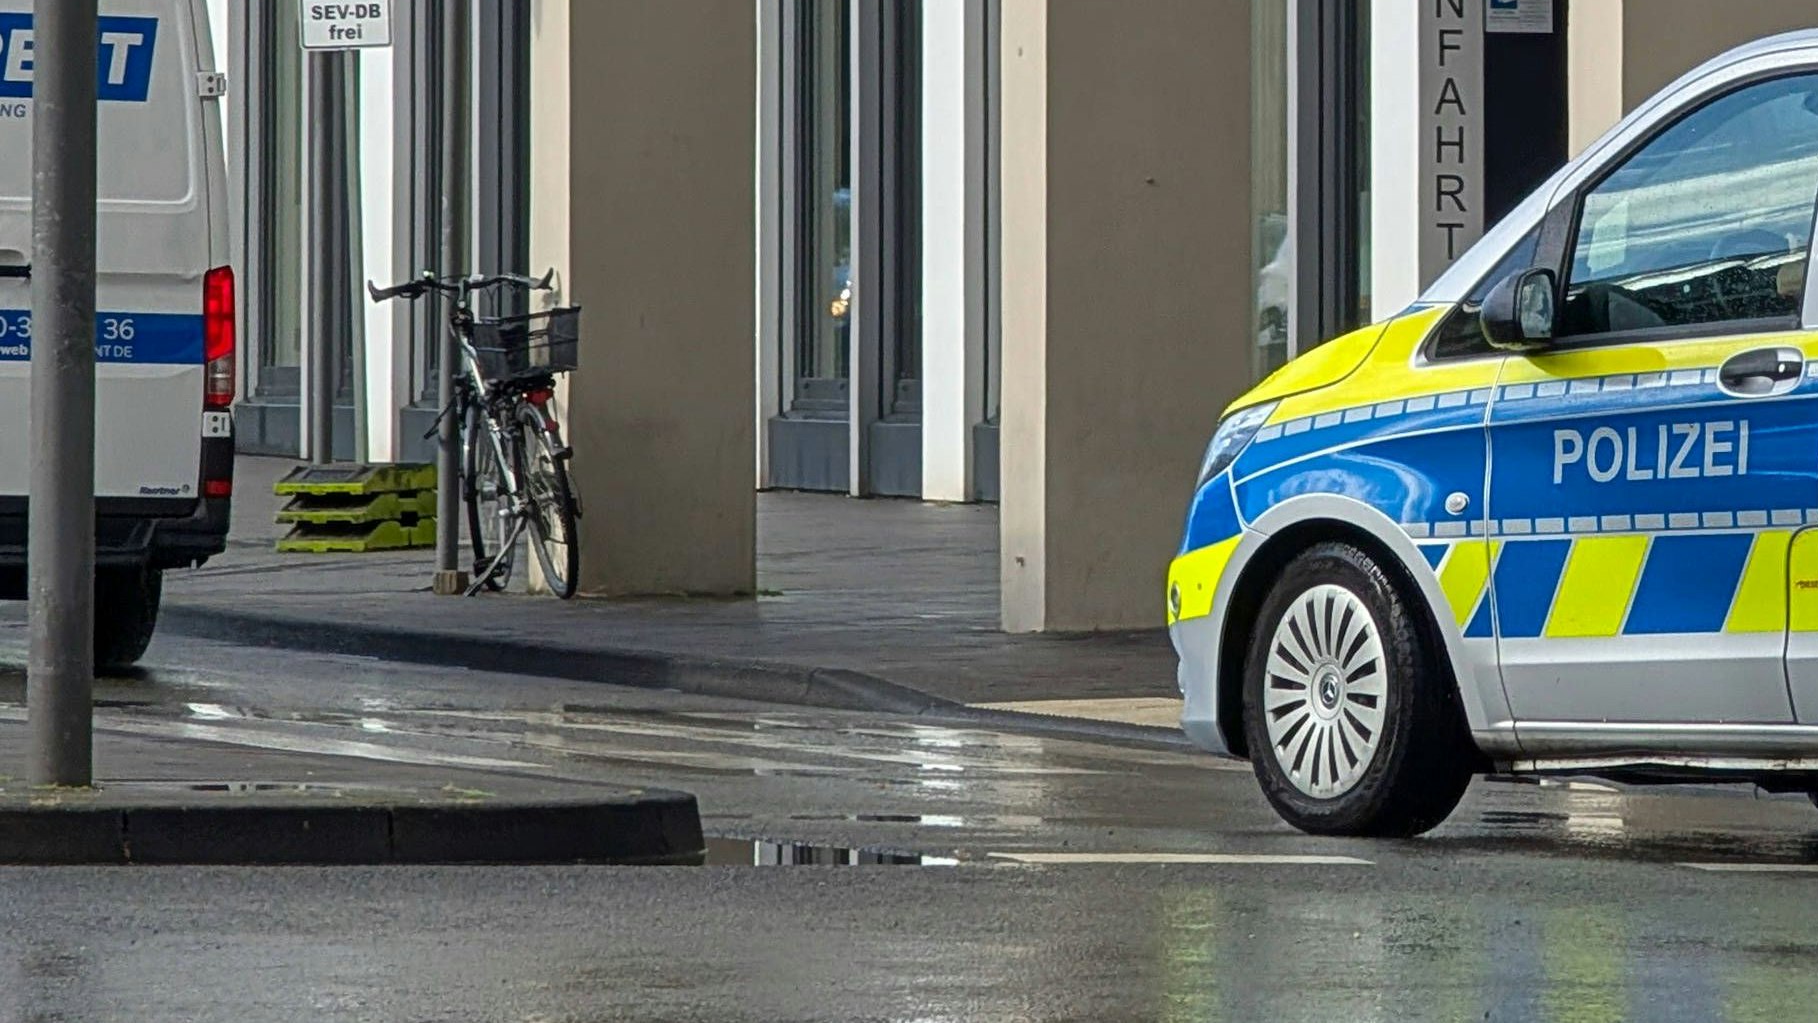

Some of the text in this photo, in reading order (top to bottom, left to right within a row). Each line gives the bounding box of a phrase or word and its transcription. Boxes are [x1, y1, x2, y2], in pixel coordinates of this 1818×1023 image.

[311, 4, 381, 20] SEV-DB
[328, 26, 363, 40] frei
[104, 319, 134, 340] 36
[1552, 419, 1749, 484] POLIZEI
